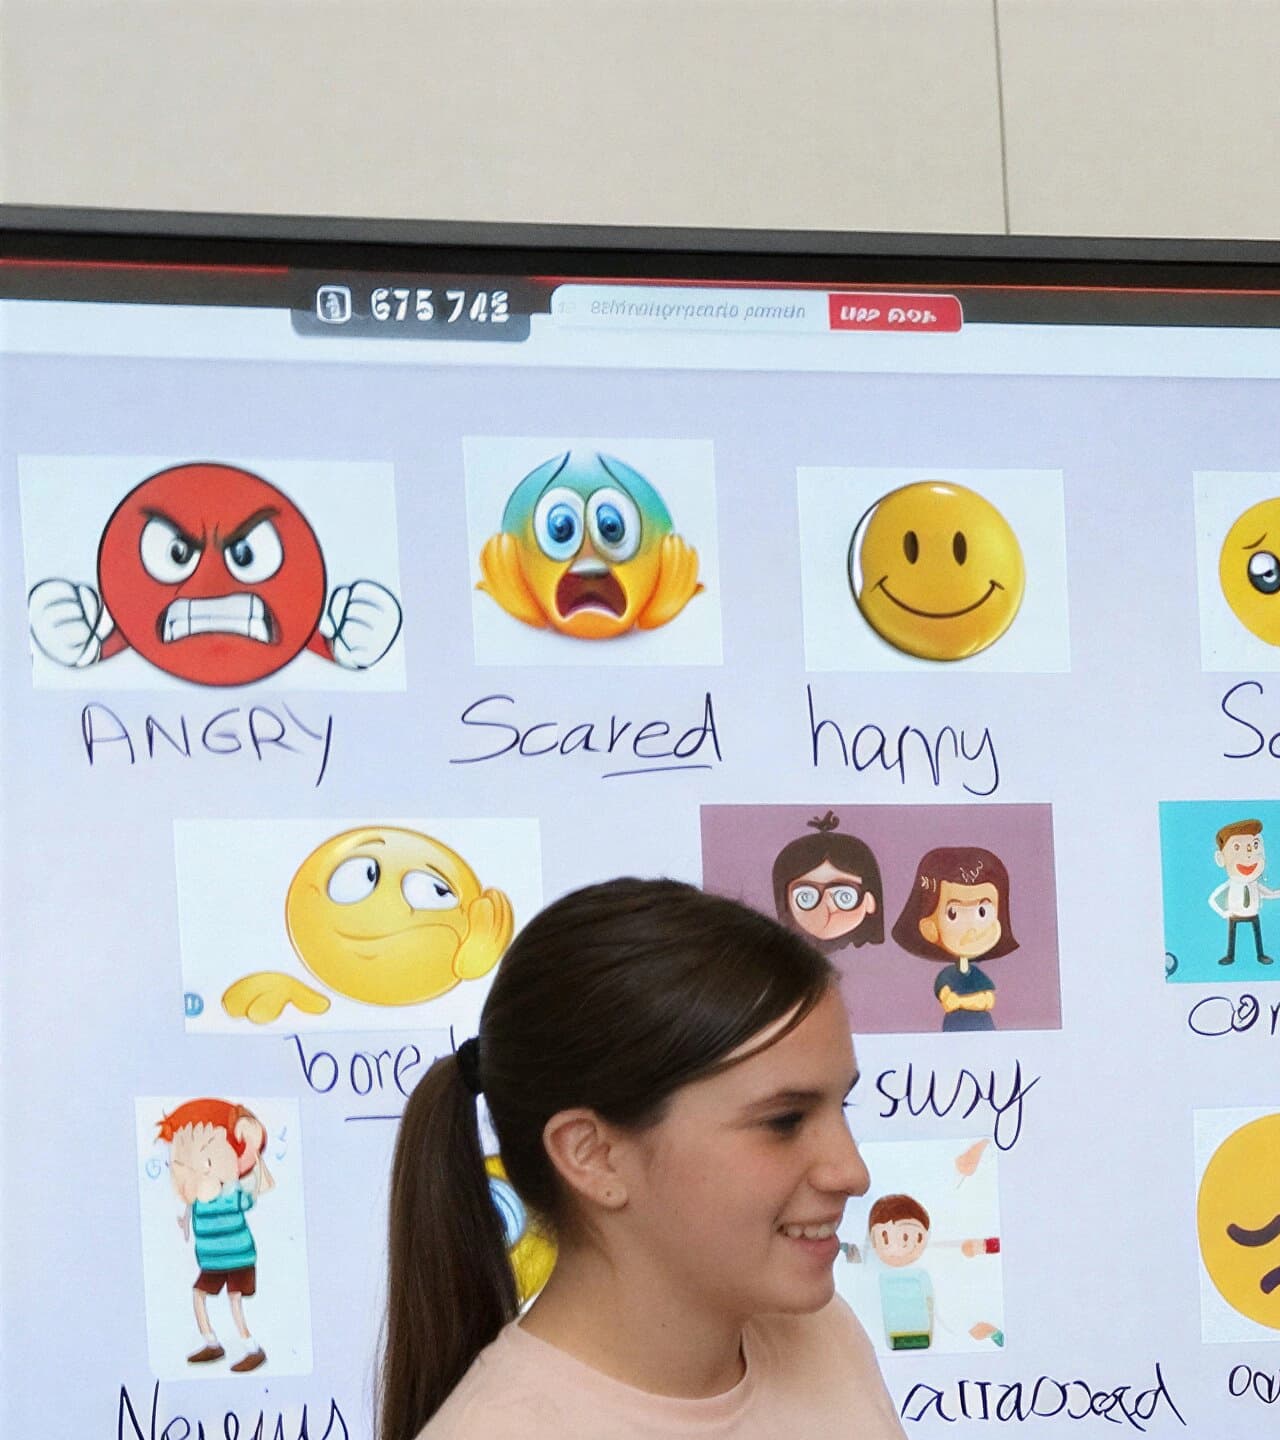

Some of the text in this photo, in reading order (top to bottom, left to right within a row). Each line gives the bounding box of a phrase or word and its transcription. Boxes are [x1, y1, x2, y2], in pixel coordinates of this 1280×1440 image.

[370, 287, 434, 322] 675
[81, 700, 333, 788] ANGRY
[449, 692, 722, 778] Scared
